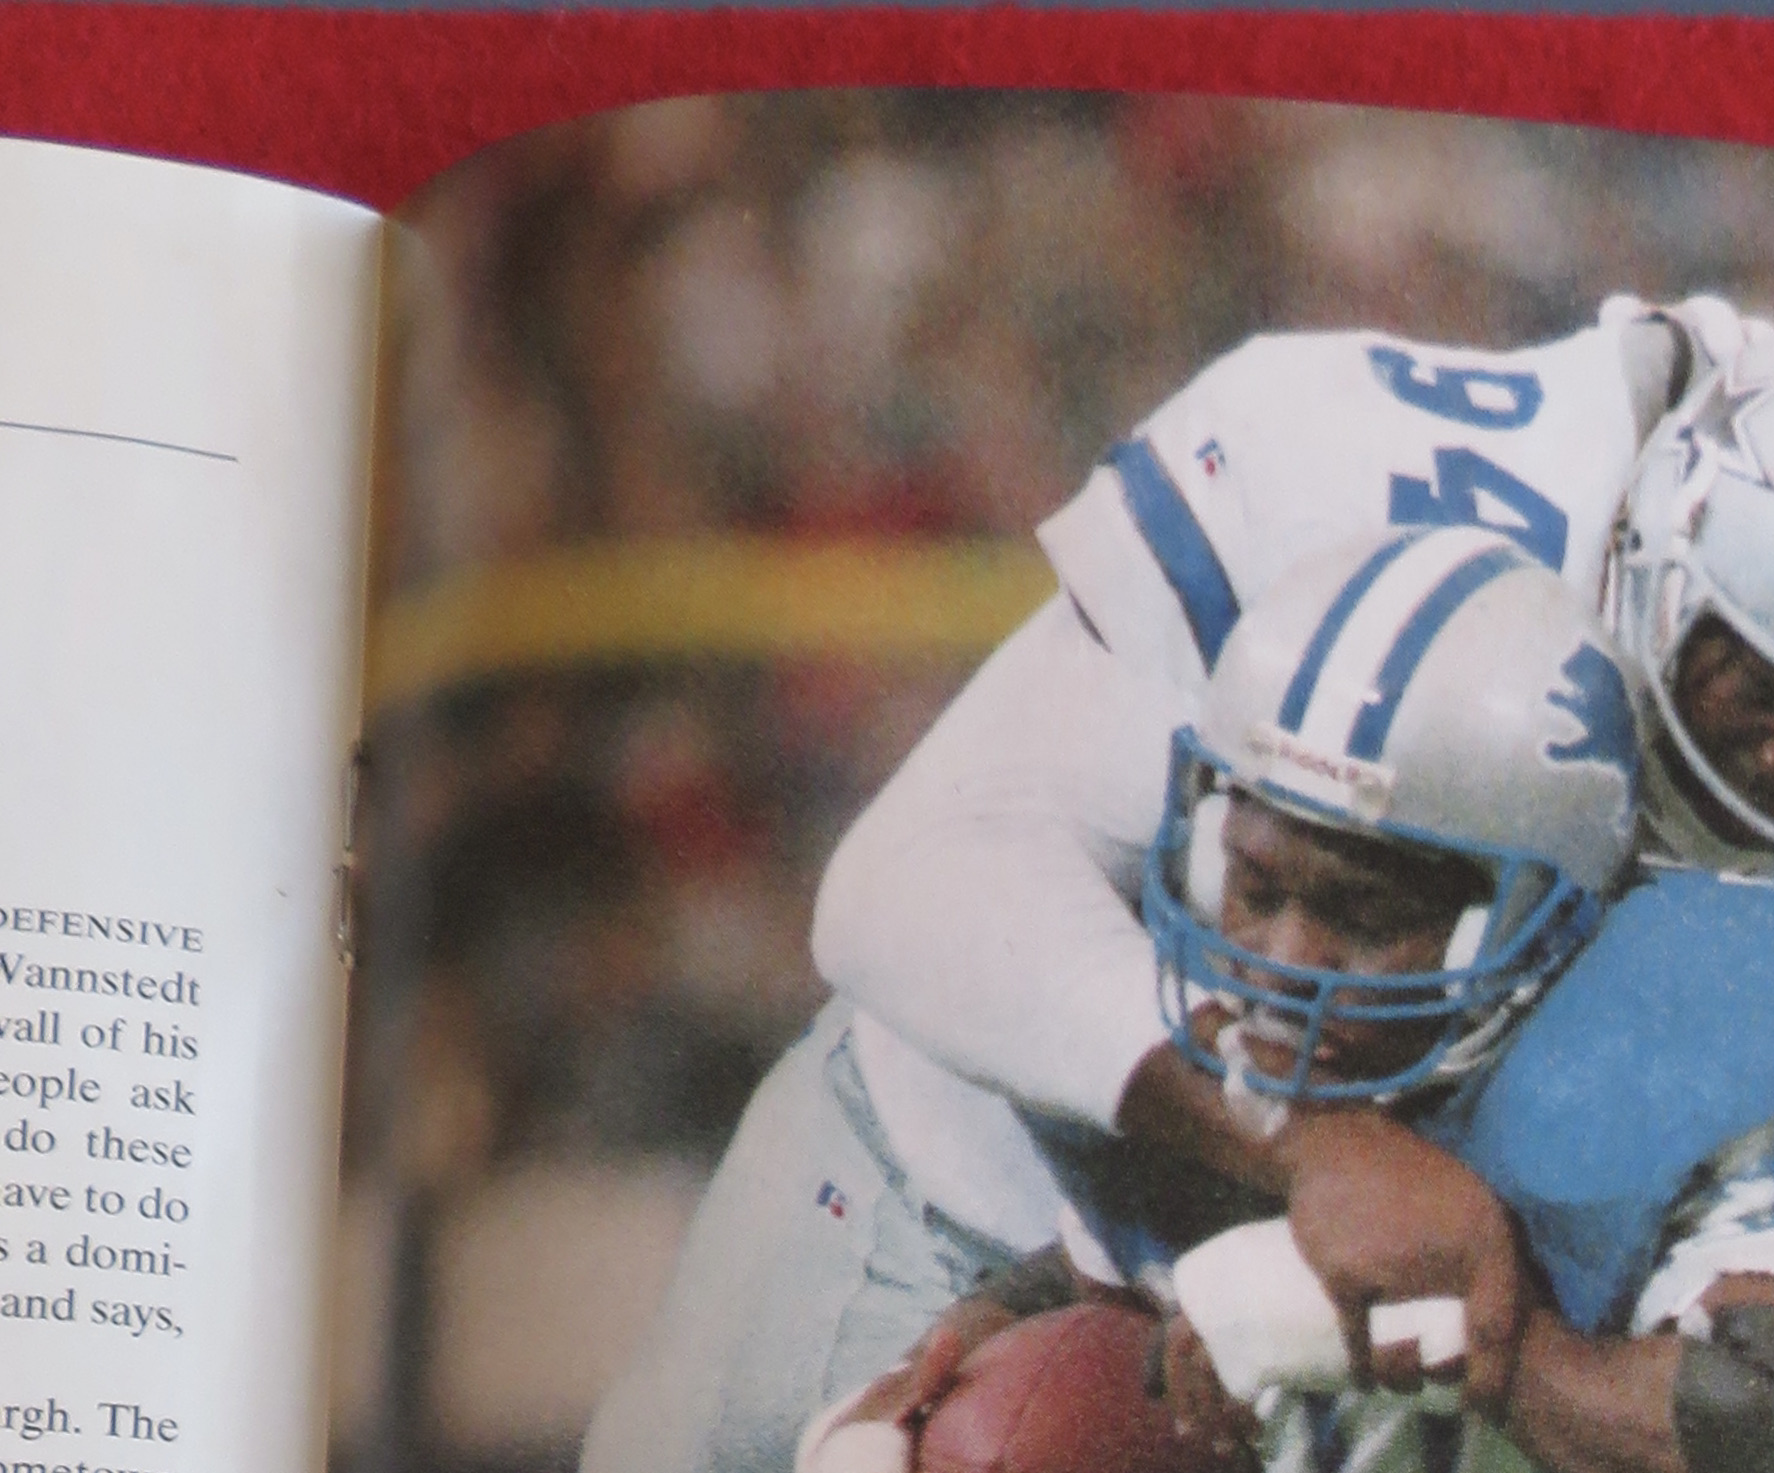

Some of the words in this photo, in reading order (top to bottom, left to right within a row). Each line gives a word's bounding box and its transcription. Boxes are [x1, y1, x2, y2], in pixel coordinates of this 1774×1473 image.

[81, 1018, 127, 1051] of
[143, 1021, 198, 1060] his
[130, 1080, 195, 1115] ask
[4, 1118, 56, 1154] do
[86, 1126, 192, 1168] these
[85, 1185, 126, 1215] to
[138, 1187, 189, 1223] do
[26, 1240, 48, 1264] a
[66, 1234, 186, 1276] domi-
[98, 1403, 178, 1442] The
